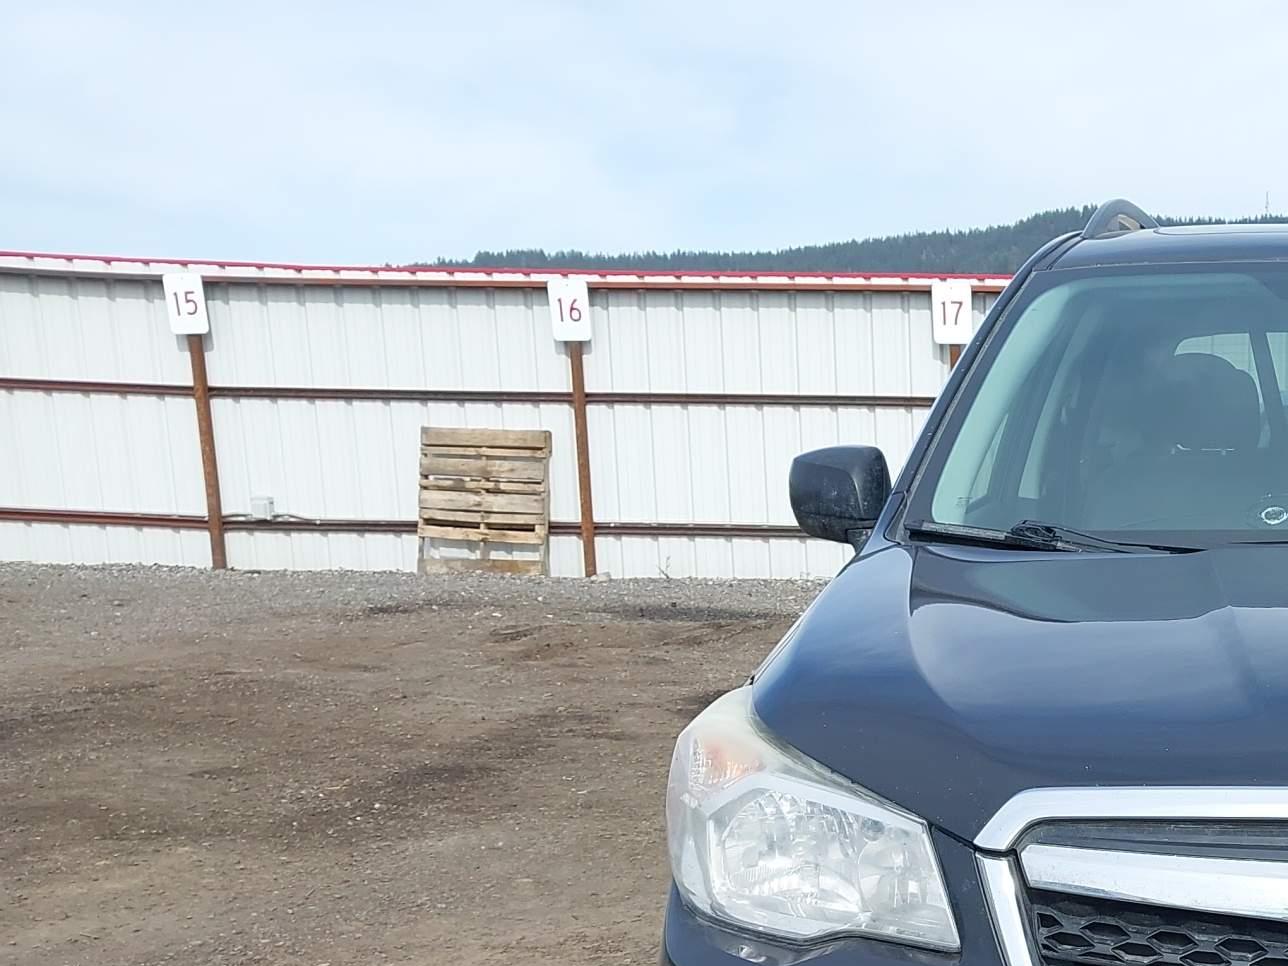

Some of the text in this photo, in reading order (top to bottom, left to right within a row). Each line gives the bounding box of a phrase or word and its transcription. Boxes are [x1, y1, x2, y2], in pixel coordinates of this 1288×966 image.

[172, 290, 198, 316] 15
[557, 297, 582, 323] 16
[940, 300, 964, 326] 17
